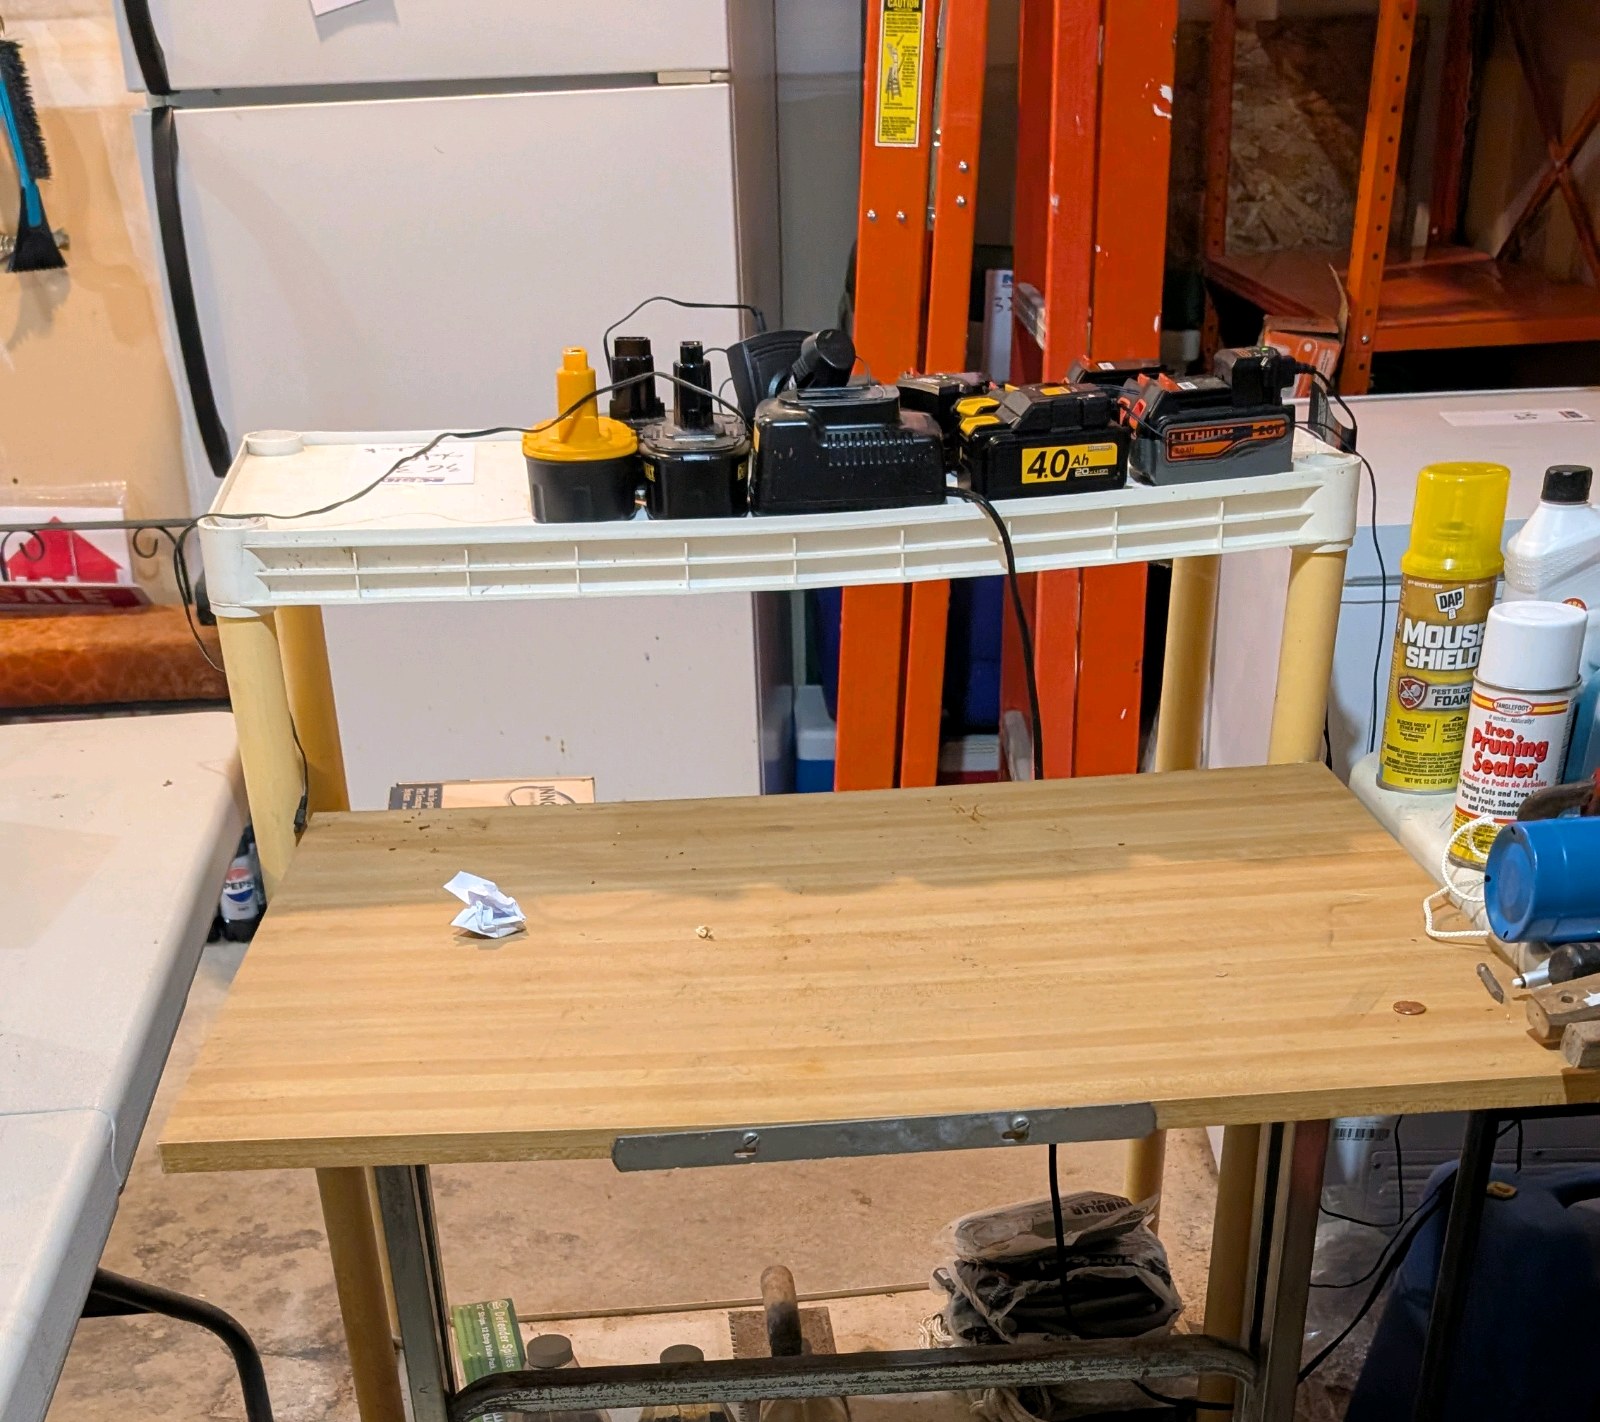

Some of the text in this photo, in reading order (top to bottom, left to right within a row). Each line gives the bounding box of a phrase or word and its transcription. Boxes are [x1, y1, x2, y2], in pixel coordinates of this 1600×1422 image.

[1027, 449, 1089, 479] 4.0 Ah
[1439, 591, 1463, 609] DAP
[1406, 646, 1480, 670] SHIELD
[1485, 720, 1514, 739] Tree
[1472, 727, 1549, 762] Pruning
[1472, 751, 1538, 778] Sealer
[1481, 787, 1495, 796] Cuts
[495, 1312, 511, 1342] Defender
[500, 1343, 516, 1368] Spikes
